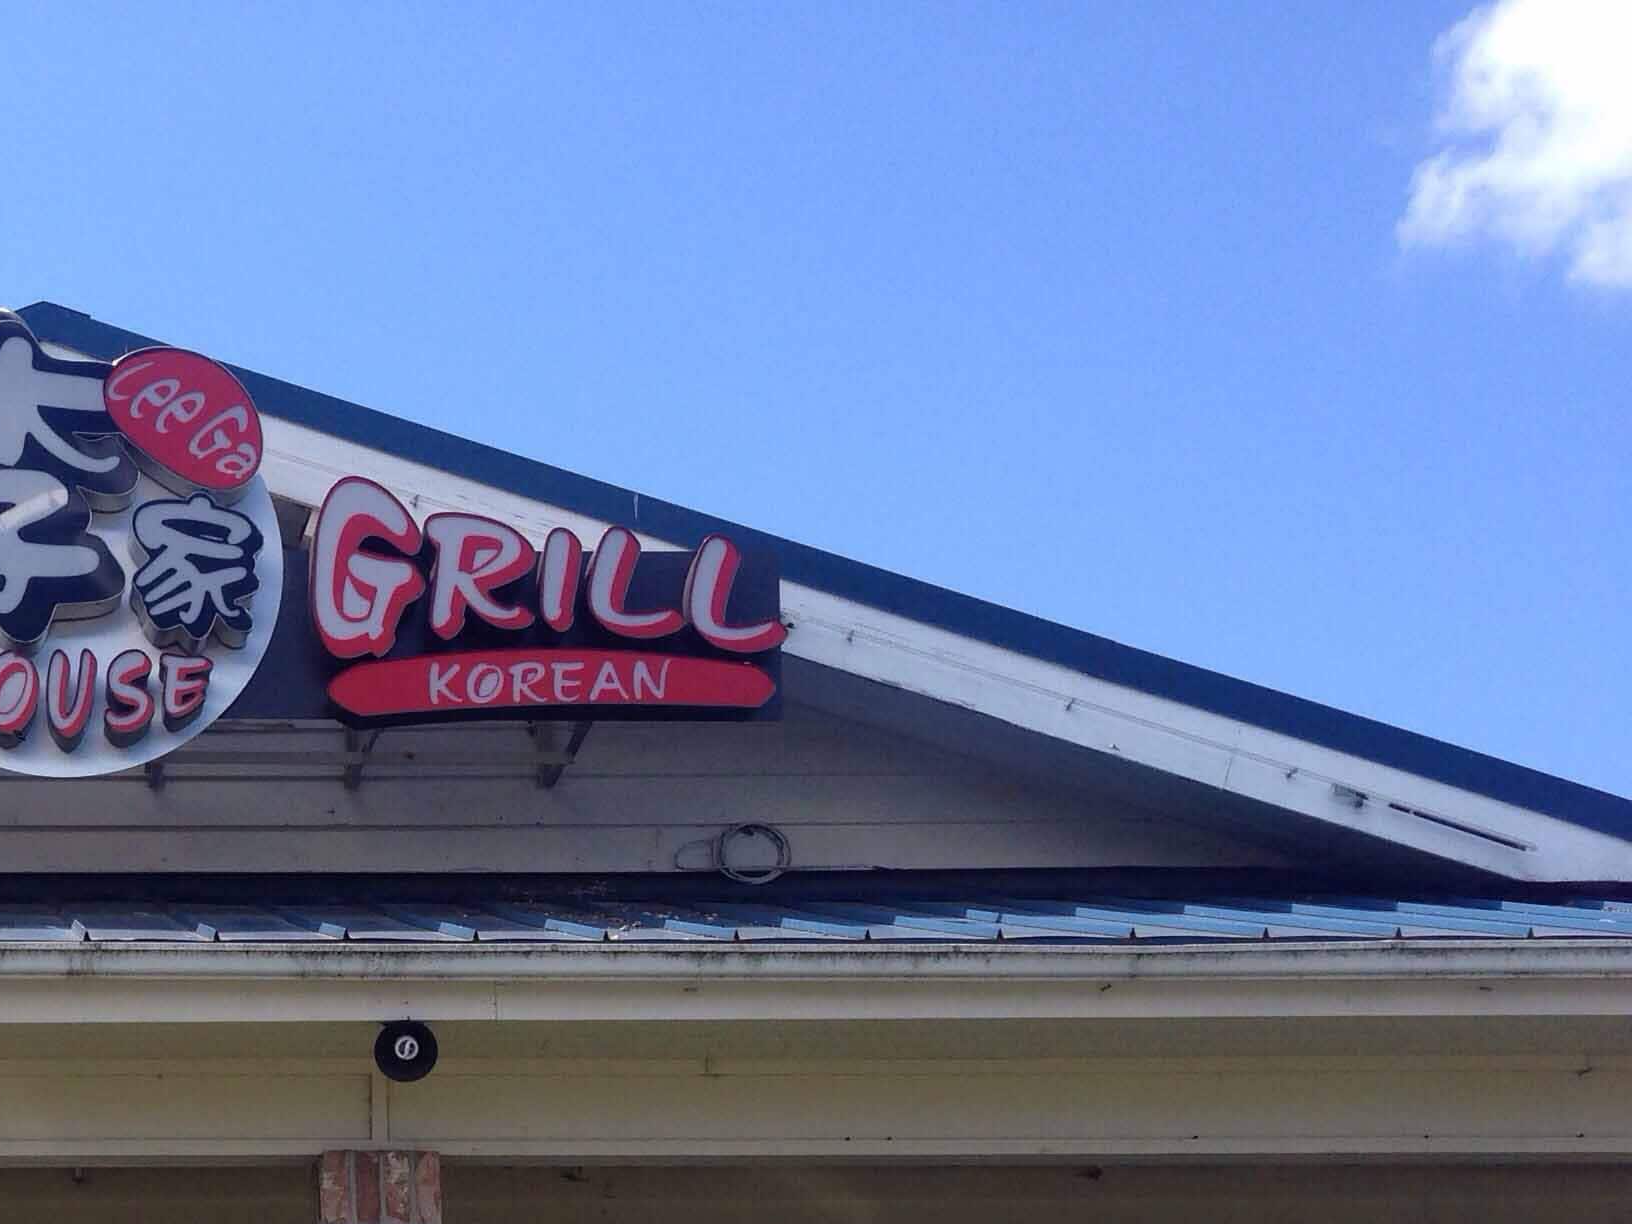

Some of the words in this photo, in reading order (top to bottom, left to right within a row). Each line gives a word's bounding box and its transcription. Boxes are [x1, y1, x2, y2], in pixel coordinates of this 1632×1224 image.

[109, 361, 205, 434] Lee
[188, 405, 256, 480] Ga
[310, 476, 788, 657] GRILL
[427, 657, 670, 703] KOREAN
